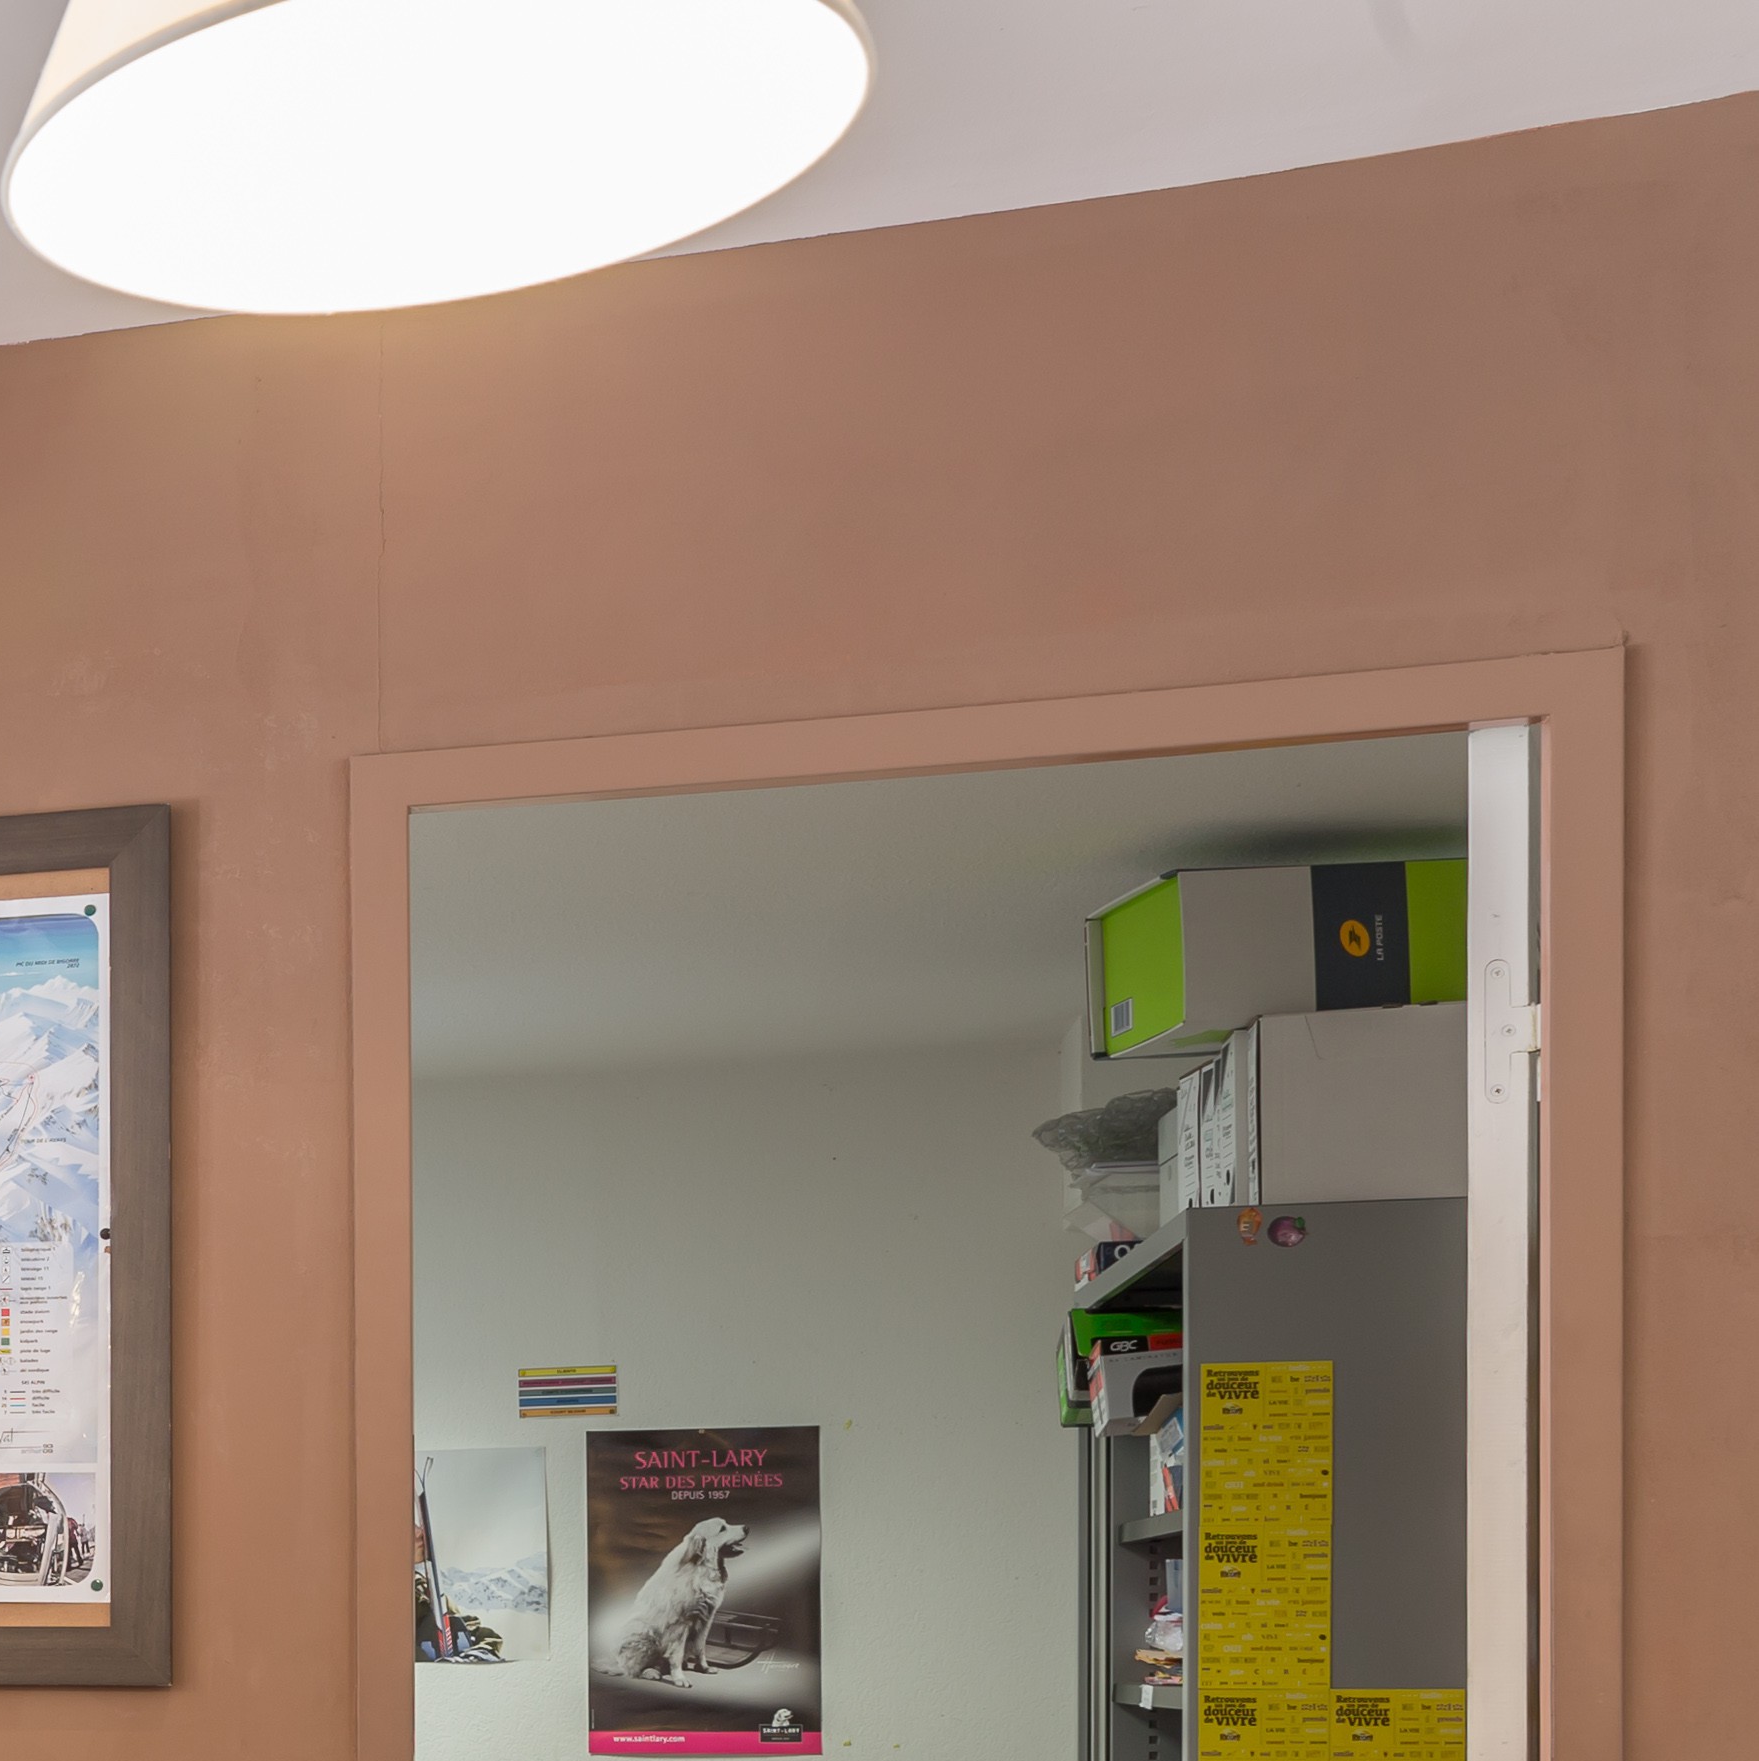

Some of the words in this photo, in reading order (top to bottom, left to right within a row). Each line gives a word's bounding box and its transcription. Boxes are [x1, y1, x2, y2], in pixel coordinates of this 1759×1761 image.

[1375, 914, 1384, 946] POSTE
[1376, 947, 1384, 960] LA
[1110, 1340, 1138, 1352] GBC
[1206, 1369, 1260, 1378] Retrouvons
[1206, 1380, 1260, 1391] douceur
[1219, 1389, 1260, 1400] vivre
[634, 1449, 768, 1470] SAINT-LARY
[619, 1476, 659, 1491] STAR
[666, 1475, 696, 1490] DES
[701, 1470, 783, 1489] PYRÉNÉES
[671, 1490, 705, 1500] DEPUIS
[708, 1490, 730, 1500] 1957
[1204, 1532, 1258, 1540] Retrouvons
[1204, 1543, 1258, 1554] douceur
[1217, 1553, 1258, 1563] vivre
[1204, 1695, 1256, 1704] Retrouvons
[1336, 1695, 1390, 1704] Retrouvons
[1204, 1706, 1257, 1717] douceur
[1336, 1706, 1390, 1717] douceur
[1216, 1716, 1257, 1727] vivre
[1348, 1716, 1390, 1727] vivre
[613, 1734, 686, 1744] www.saintlary.com
